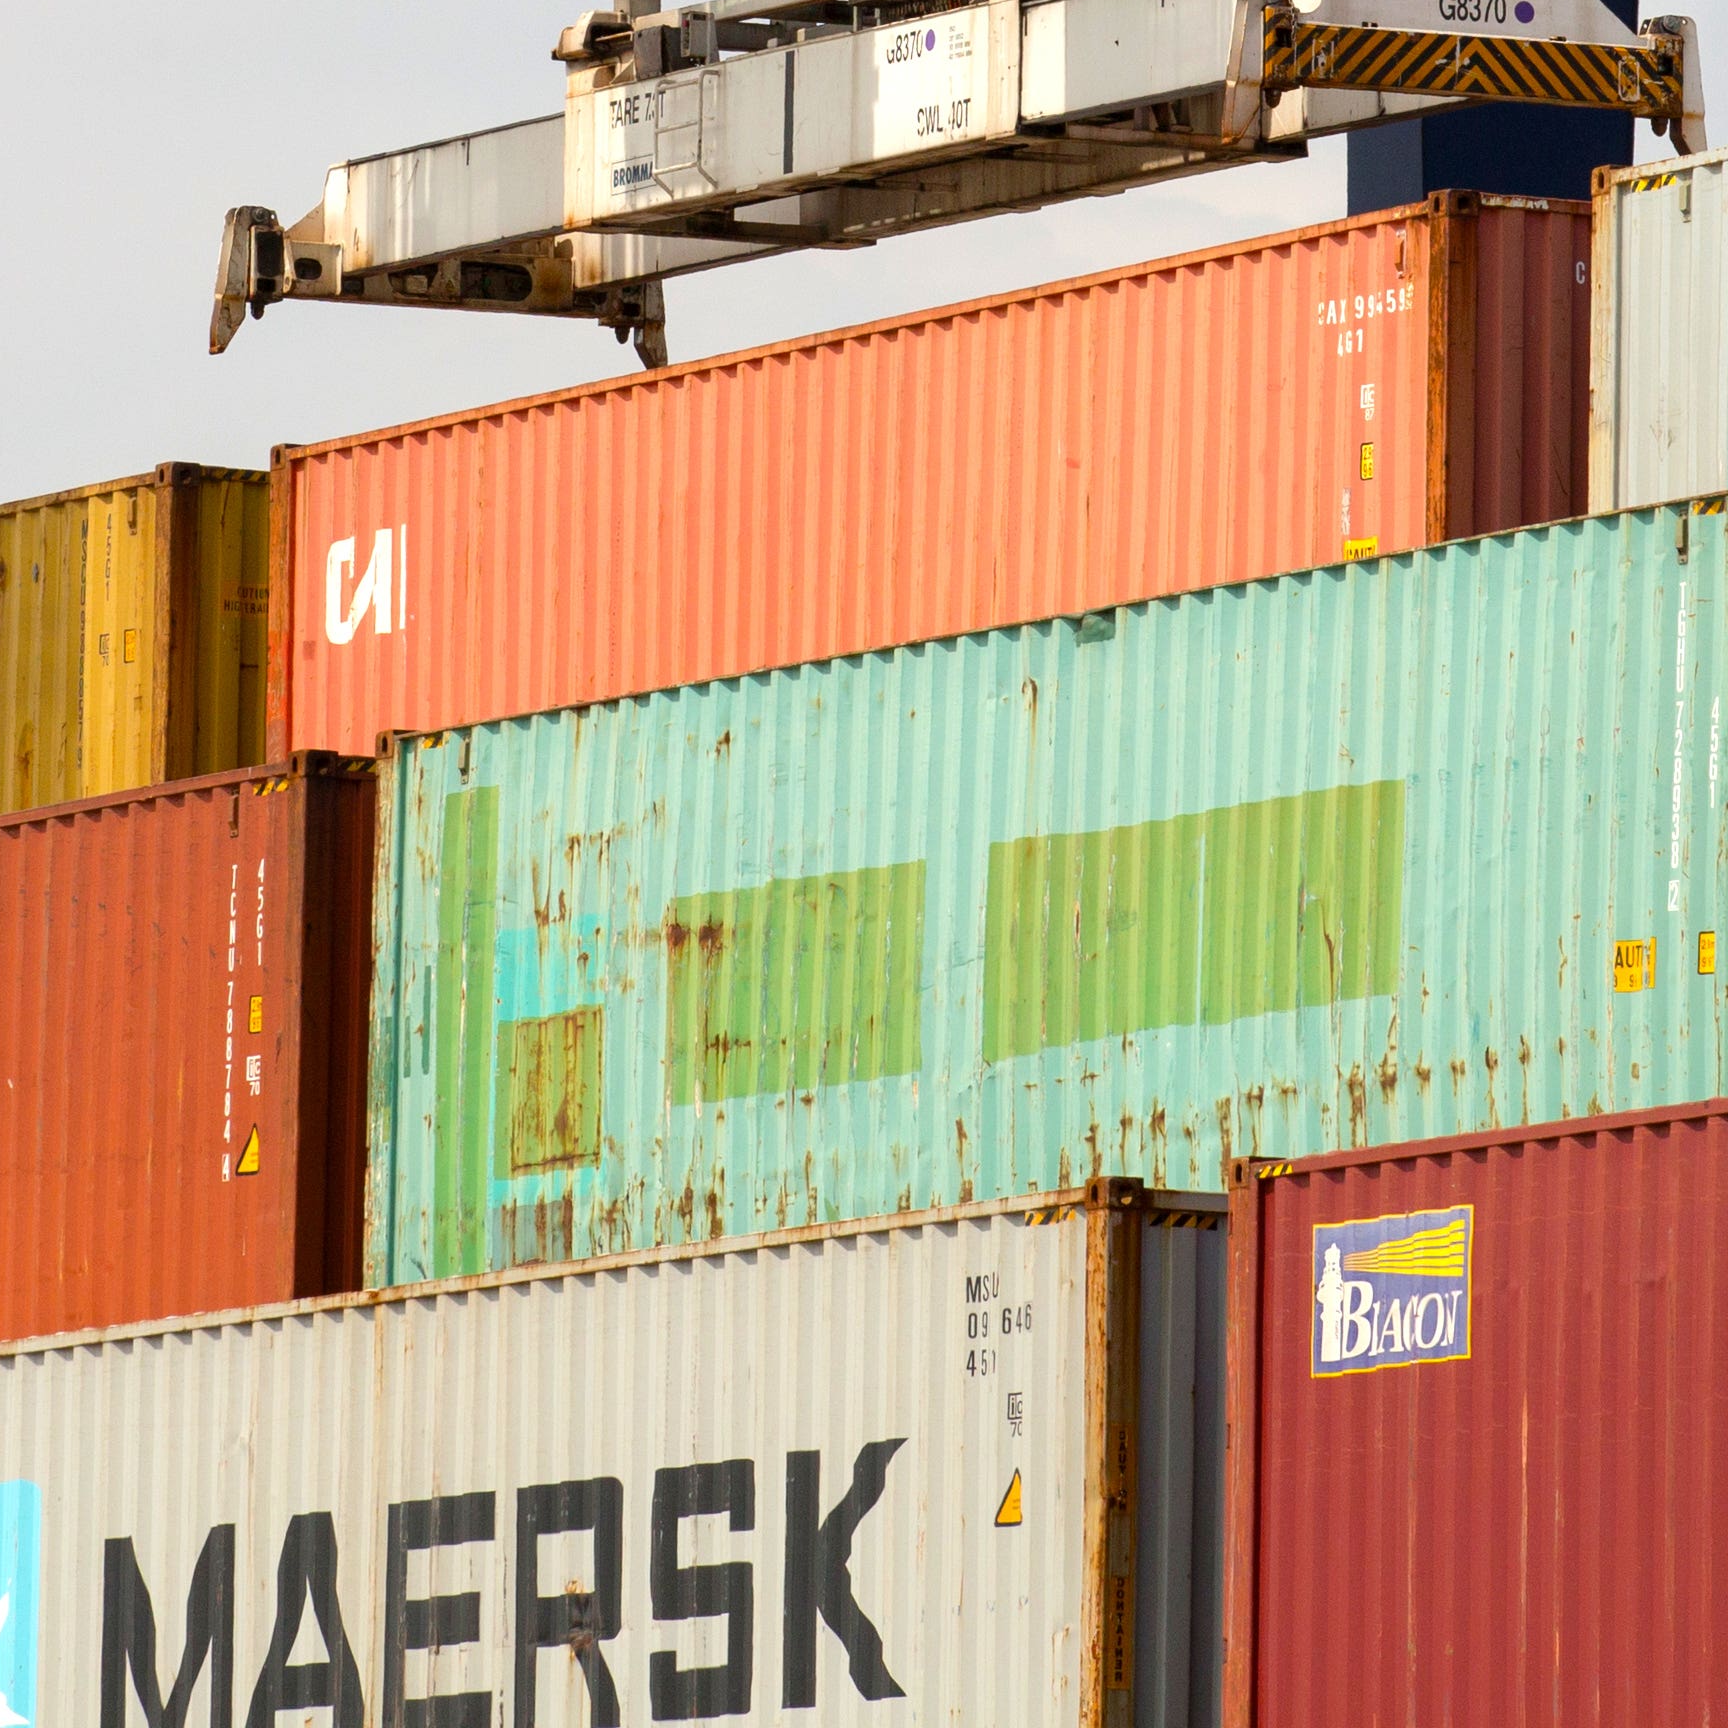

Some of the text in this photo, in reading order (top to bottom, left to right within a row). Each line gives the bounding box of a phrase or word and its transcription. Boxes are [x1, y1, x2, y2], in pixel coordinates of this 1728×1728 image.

[886, 29, 924, 65] G8370
[610, 94, 640, 129] TARE
[917, 104, 944, 137] SWL
[1676, 581, 1686, 693] TGHU
[1671, 700, 1684, 869] 728938
[1708, 696, 1720, 809] 45G1
[228, 864, 238, 972] TCNU
[256, 858, 265, 966] 45G1
[224, 980, 234, 1144] 788784
[249, 1081, 261, 1097] 70
[100, 1437, 909, 1728] MAERSK
